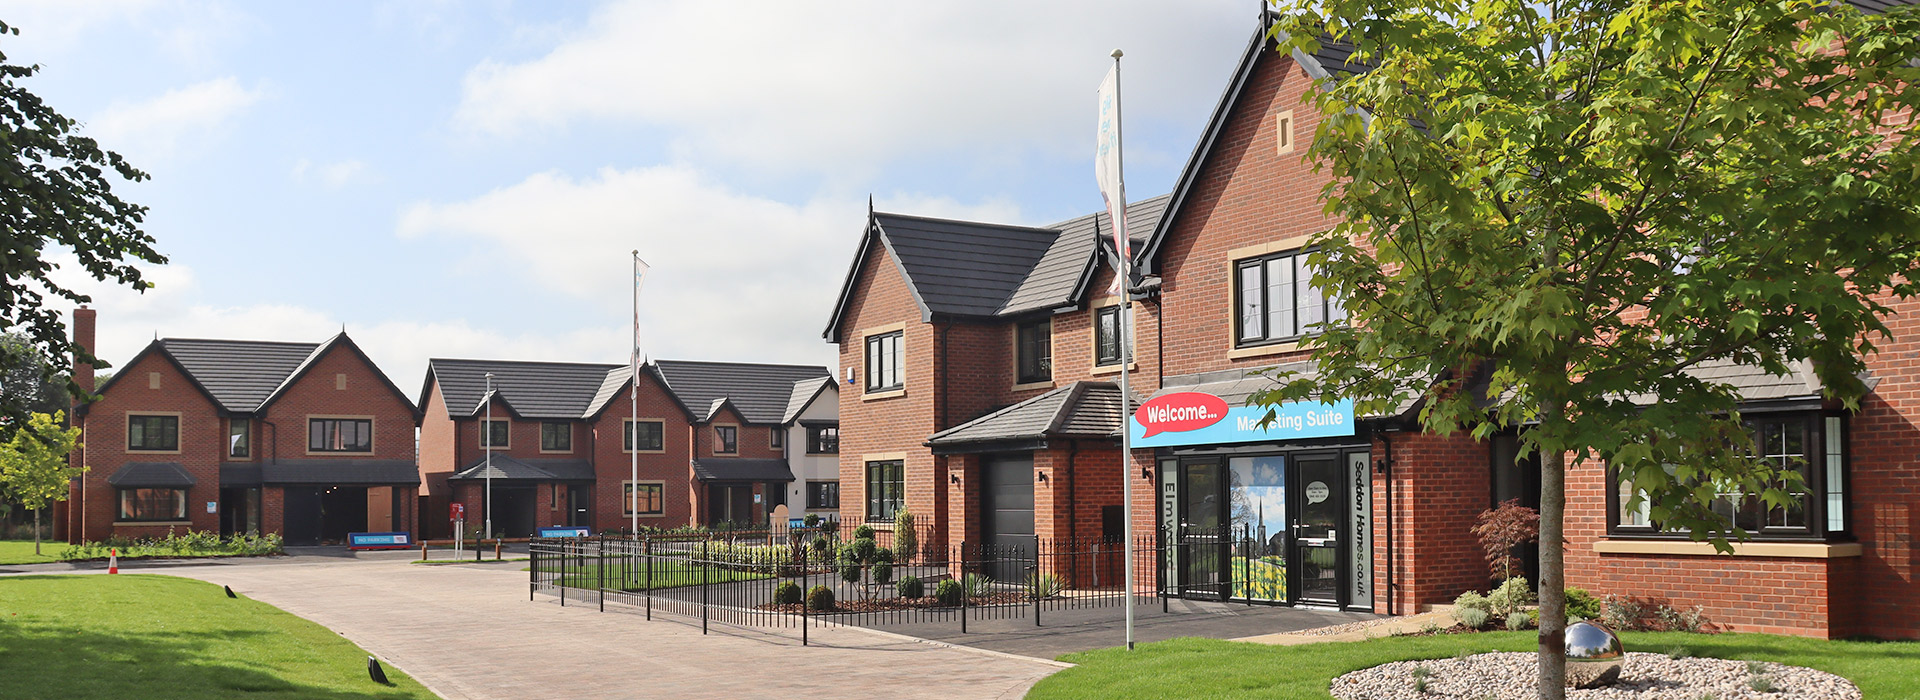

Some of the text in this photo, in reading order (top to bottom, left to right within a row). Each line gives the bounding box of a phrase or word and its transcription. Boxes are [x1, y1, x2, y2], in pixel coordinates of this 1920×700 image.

[1147, 403, 1217, 423] Welcome...
[1236, 410, 1343, 431] Mareting Suite
[1355, 461, 1365, 597] Seddon Homes.co.uk
